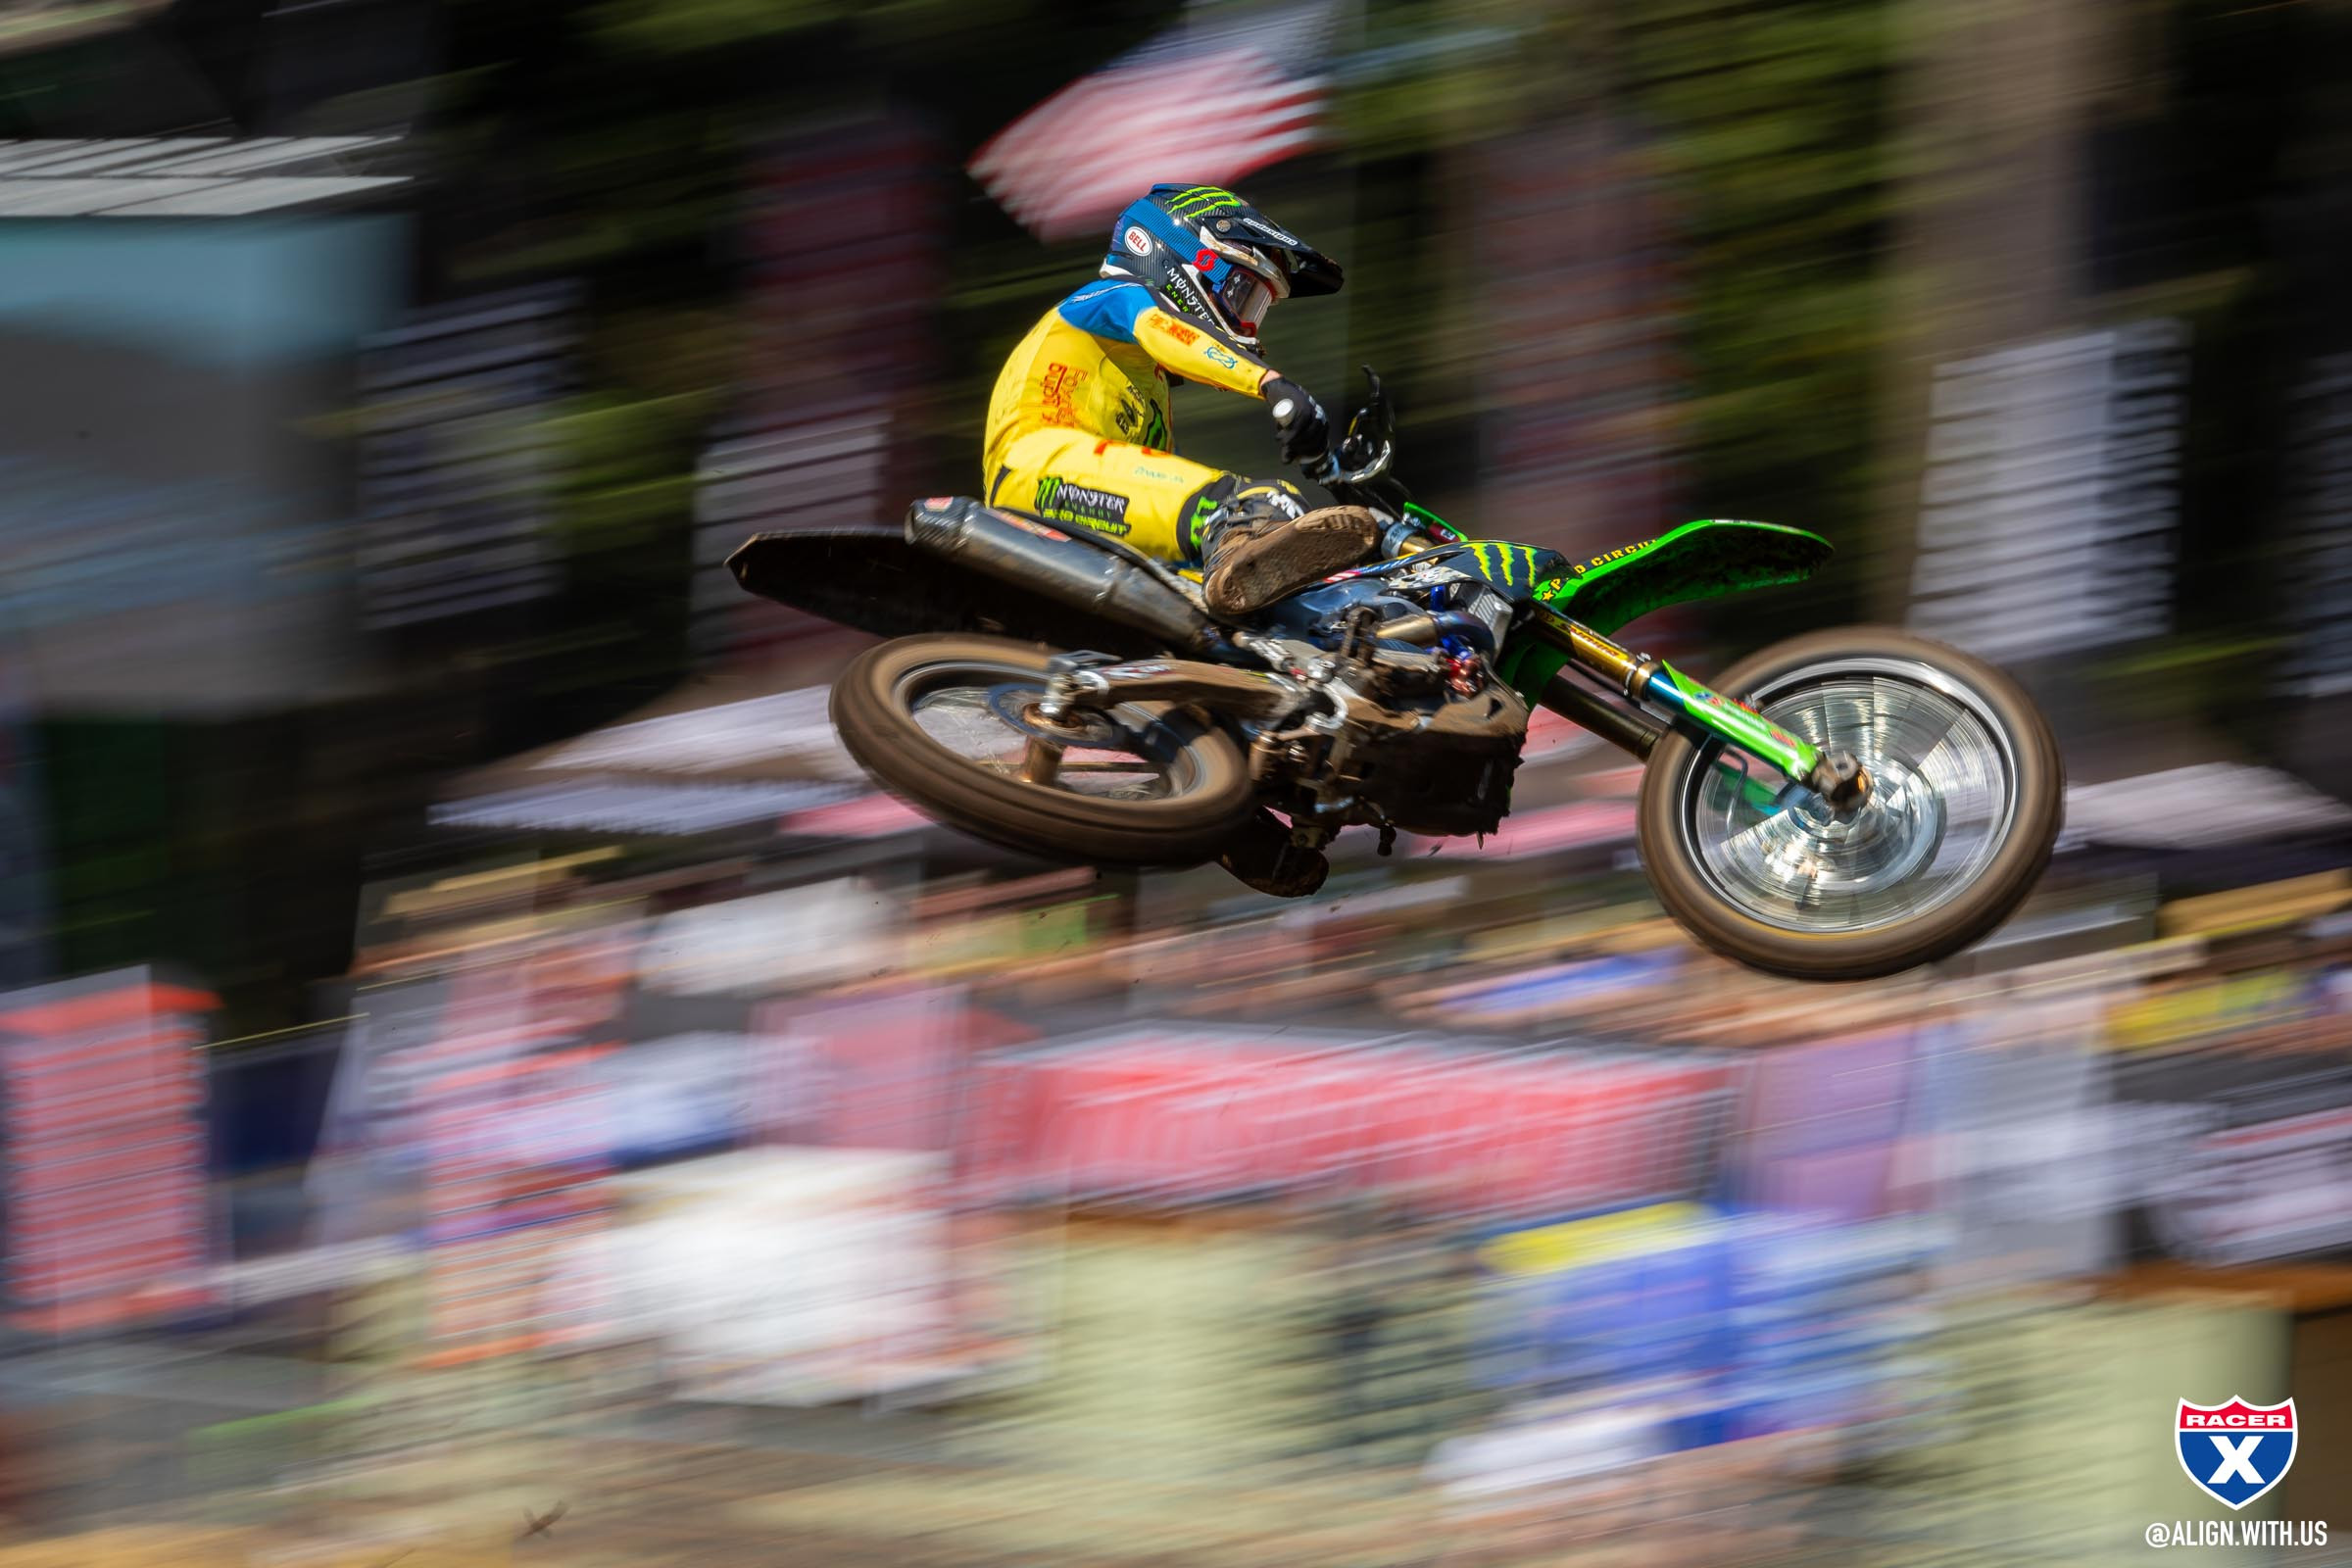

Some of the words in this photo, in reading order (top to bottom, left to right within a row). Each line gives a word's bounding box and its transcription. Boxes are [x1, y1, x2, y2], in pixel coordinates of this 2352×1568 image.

[1128, 230, 1147, 252] BELL
[1165, 283, 1191, 314] ENER
[1056, 483, 1125, 514] MONSTER
[1591, 539, 1657, 566] CIRCU
